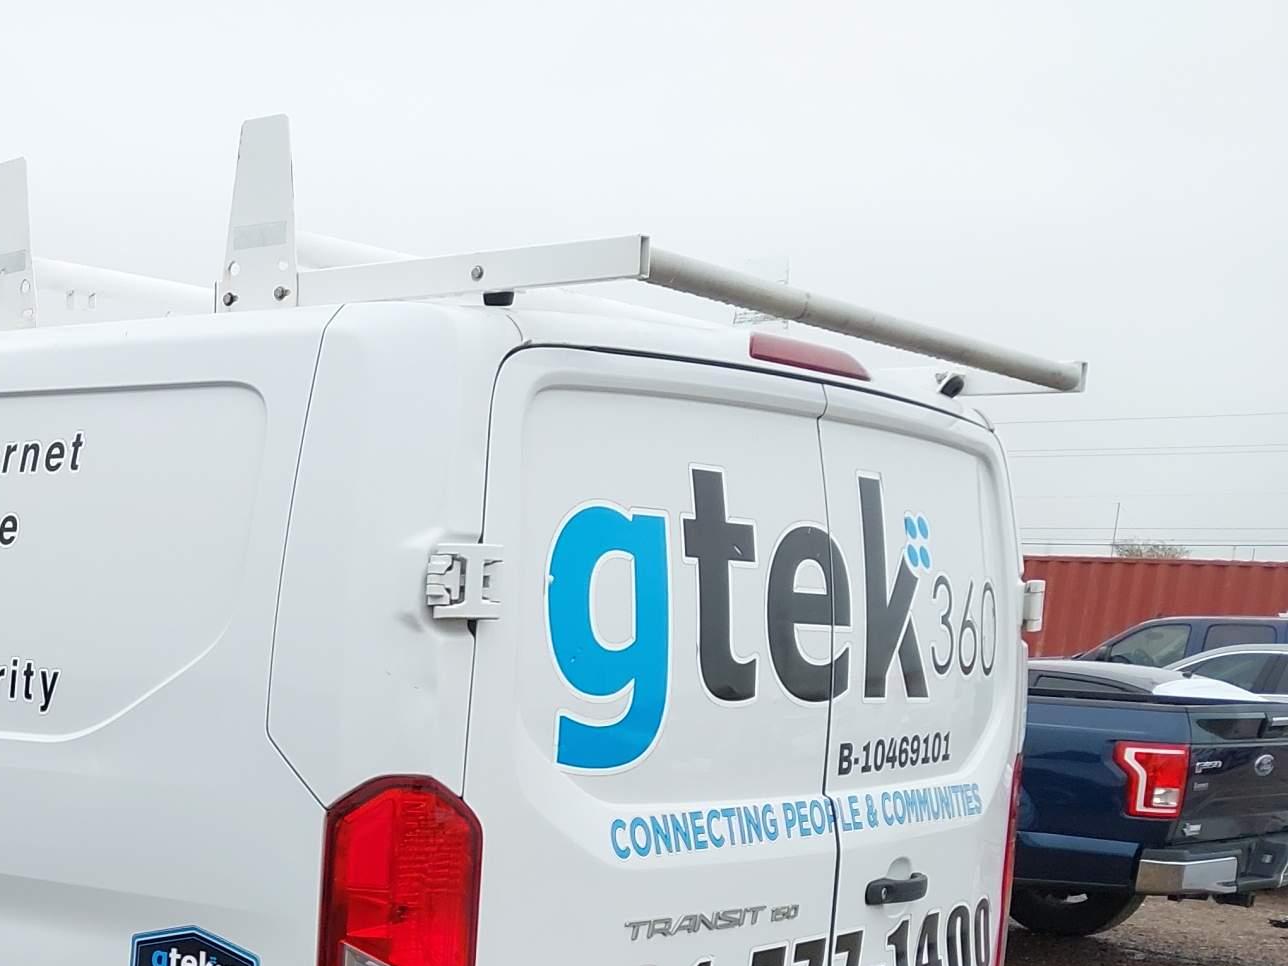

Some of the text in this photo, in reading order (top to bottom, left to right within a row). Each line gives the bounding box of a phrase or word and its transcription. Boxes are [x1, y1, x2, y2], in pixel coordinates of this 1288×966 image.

[839, 732, 951, 775] B-10469101
[612, 783, 982, 860] CONNECTING PEOPLE & COMMUNITIES
[624, 905, 767, 941] TRANSIT
